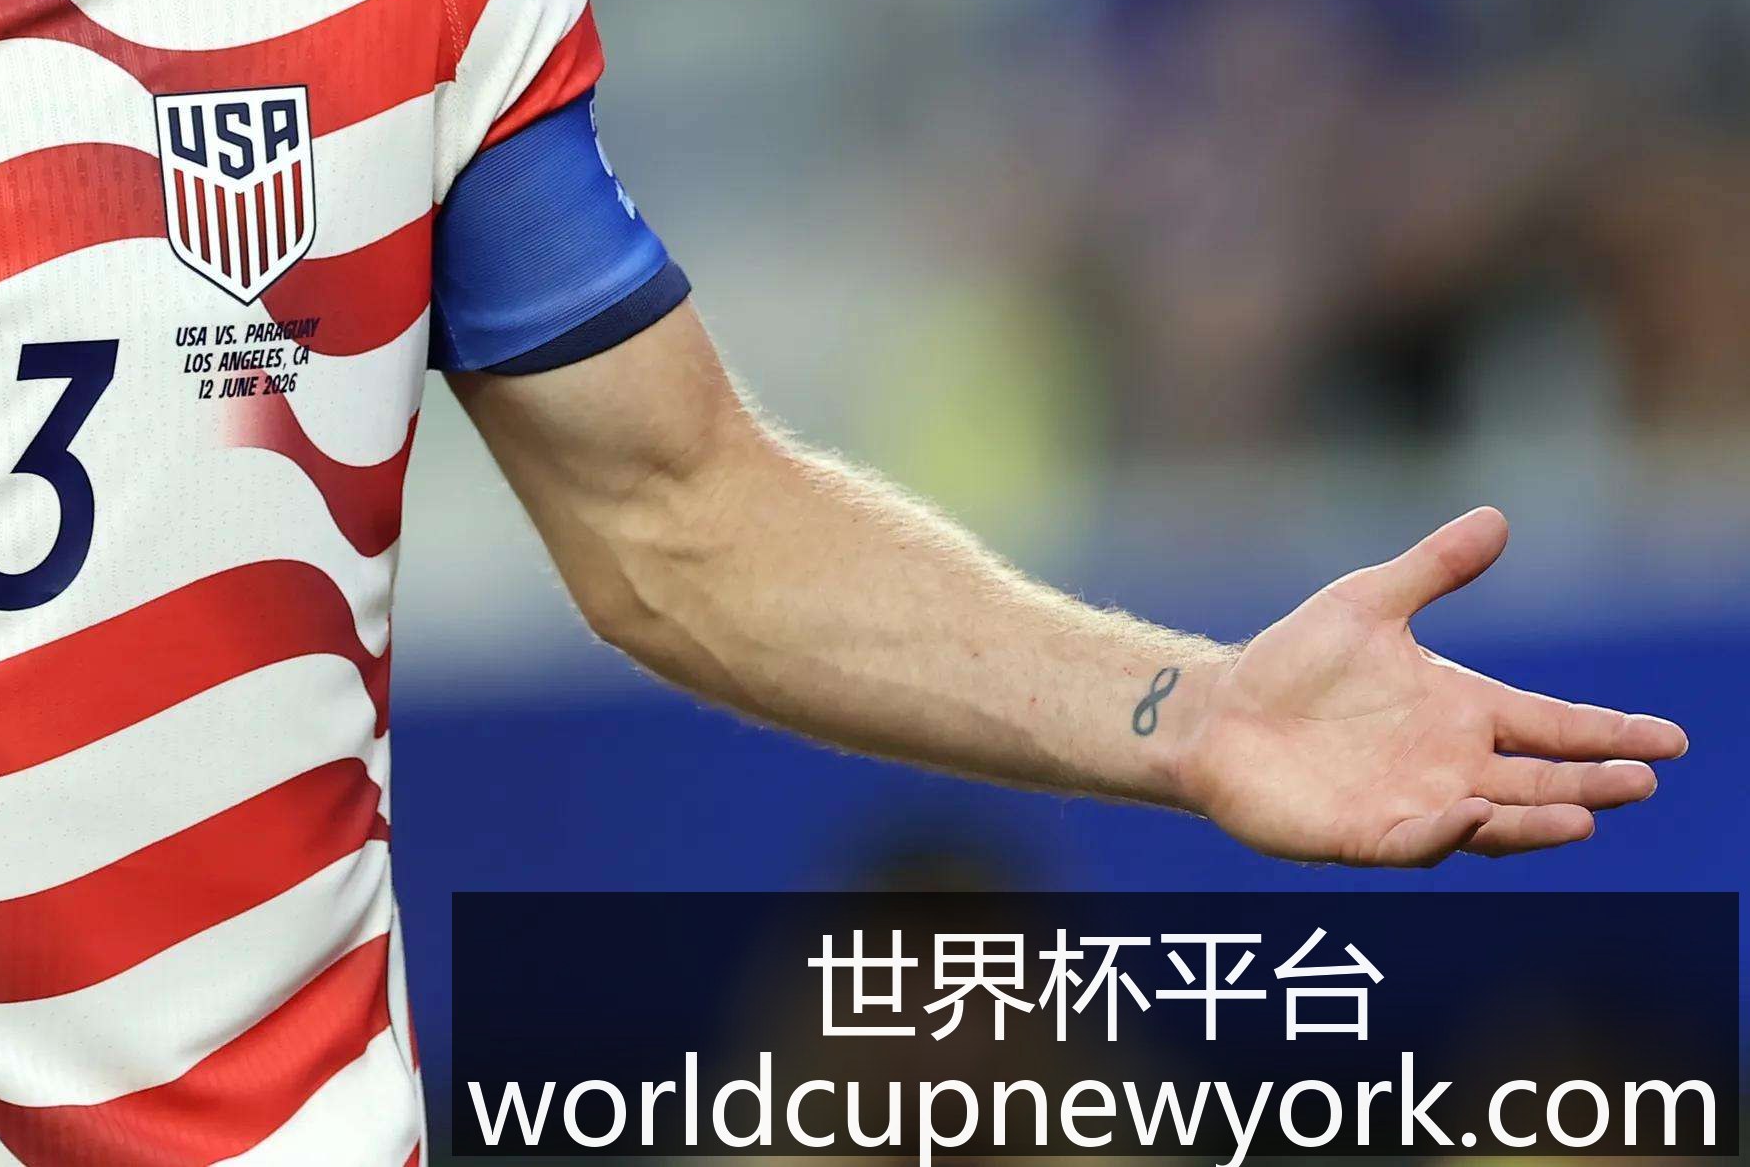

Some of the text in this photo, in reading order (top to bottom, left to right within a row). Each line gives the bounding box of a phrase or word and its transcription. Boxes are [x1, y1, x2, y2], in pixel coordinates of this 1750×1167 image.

[167, 99, 300, 180] USA
[175, 317, 321, 347] USA VS. PARAGUAY
[184, 345, 310, 374] LOS ANGELES, CA
[198, 372, 298, 400] 12 JUNE 2026
